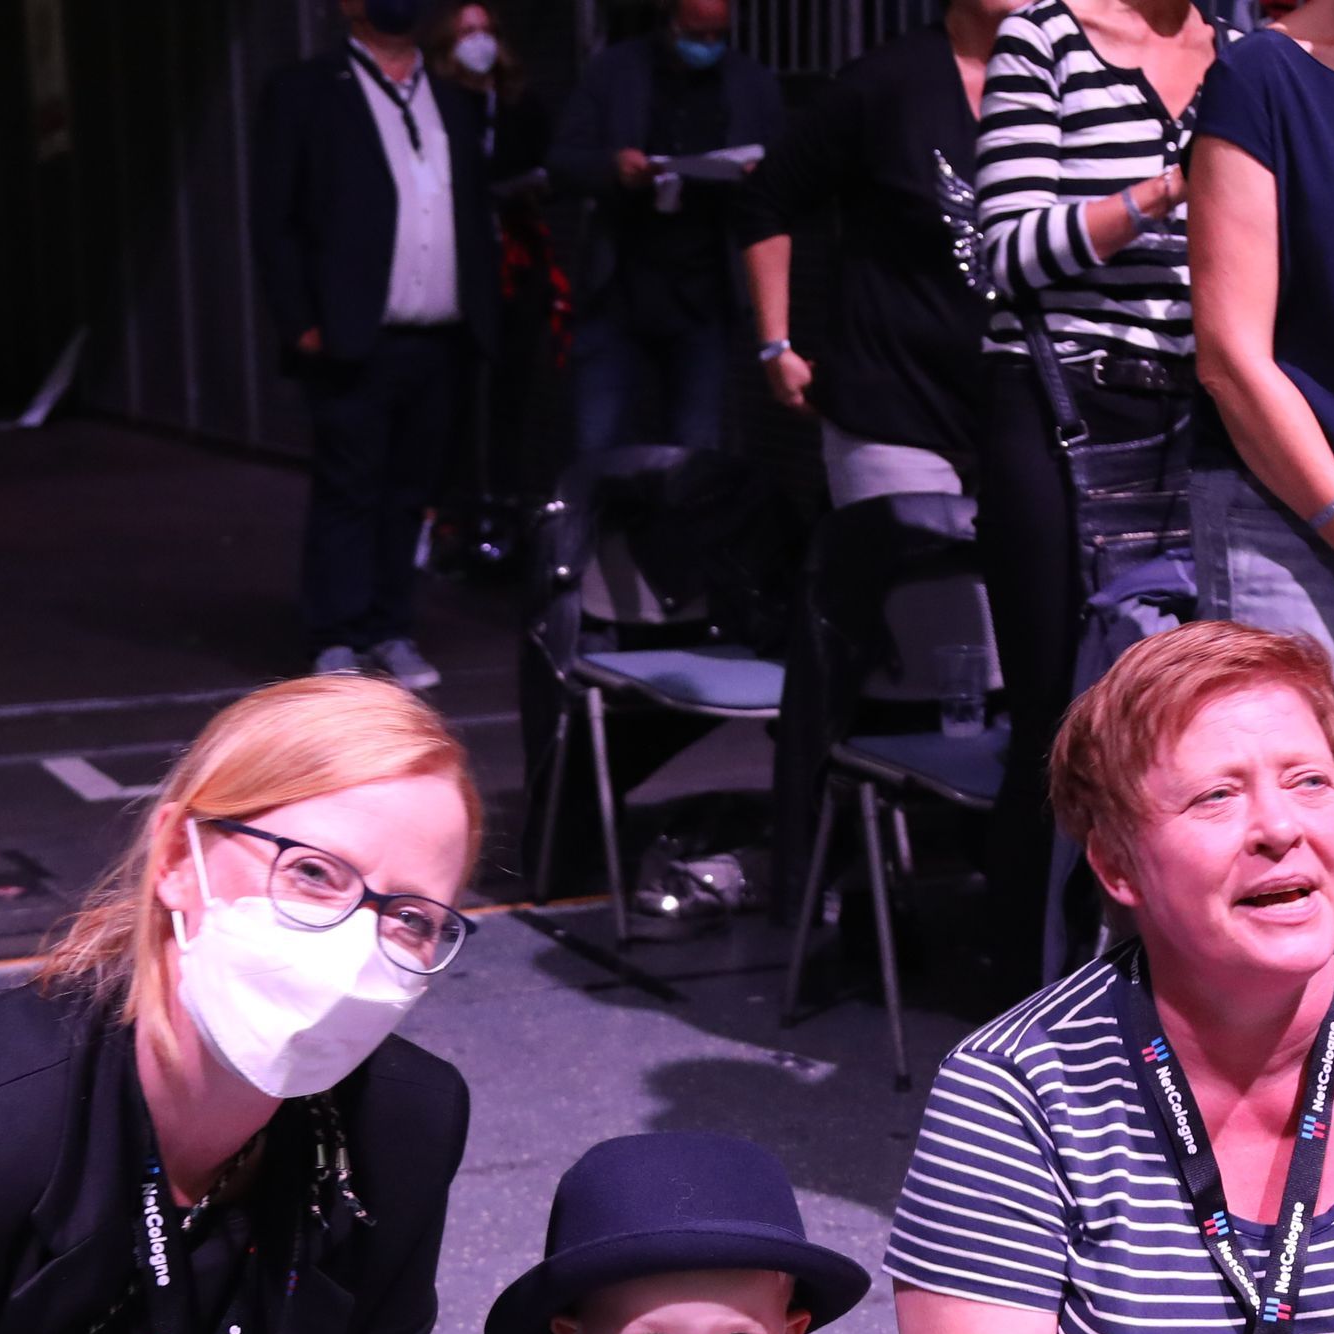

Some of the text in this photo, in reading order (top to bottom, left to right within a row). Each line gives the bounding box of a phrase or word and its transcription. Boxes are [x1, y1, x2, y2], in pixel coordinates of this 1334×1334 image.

[1156, 1065, 1198, 1155] NetCologne
[142, 1182, 171, 1287] NetCologne
[1217, 1240, 1261, 1315] NetColog
[1274, 1201, 1305, 1294] NetCologne
